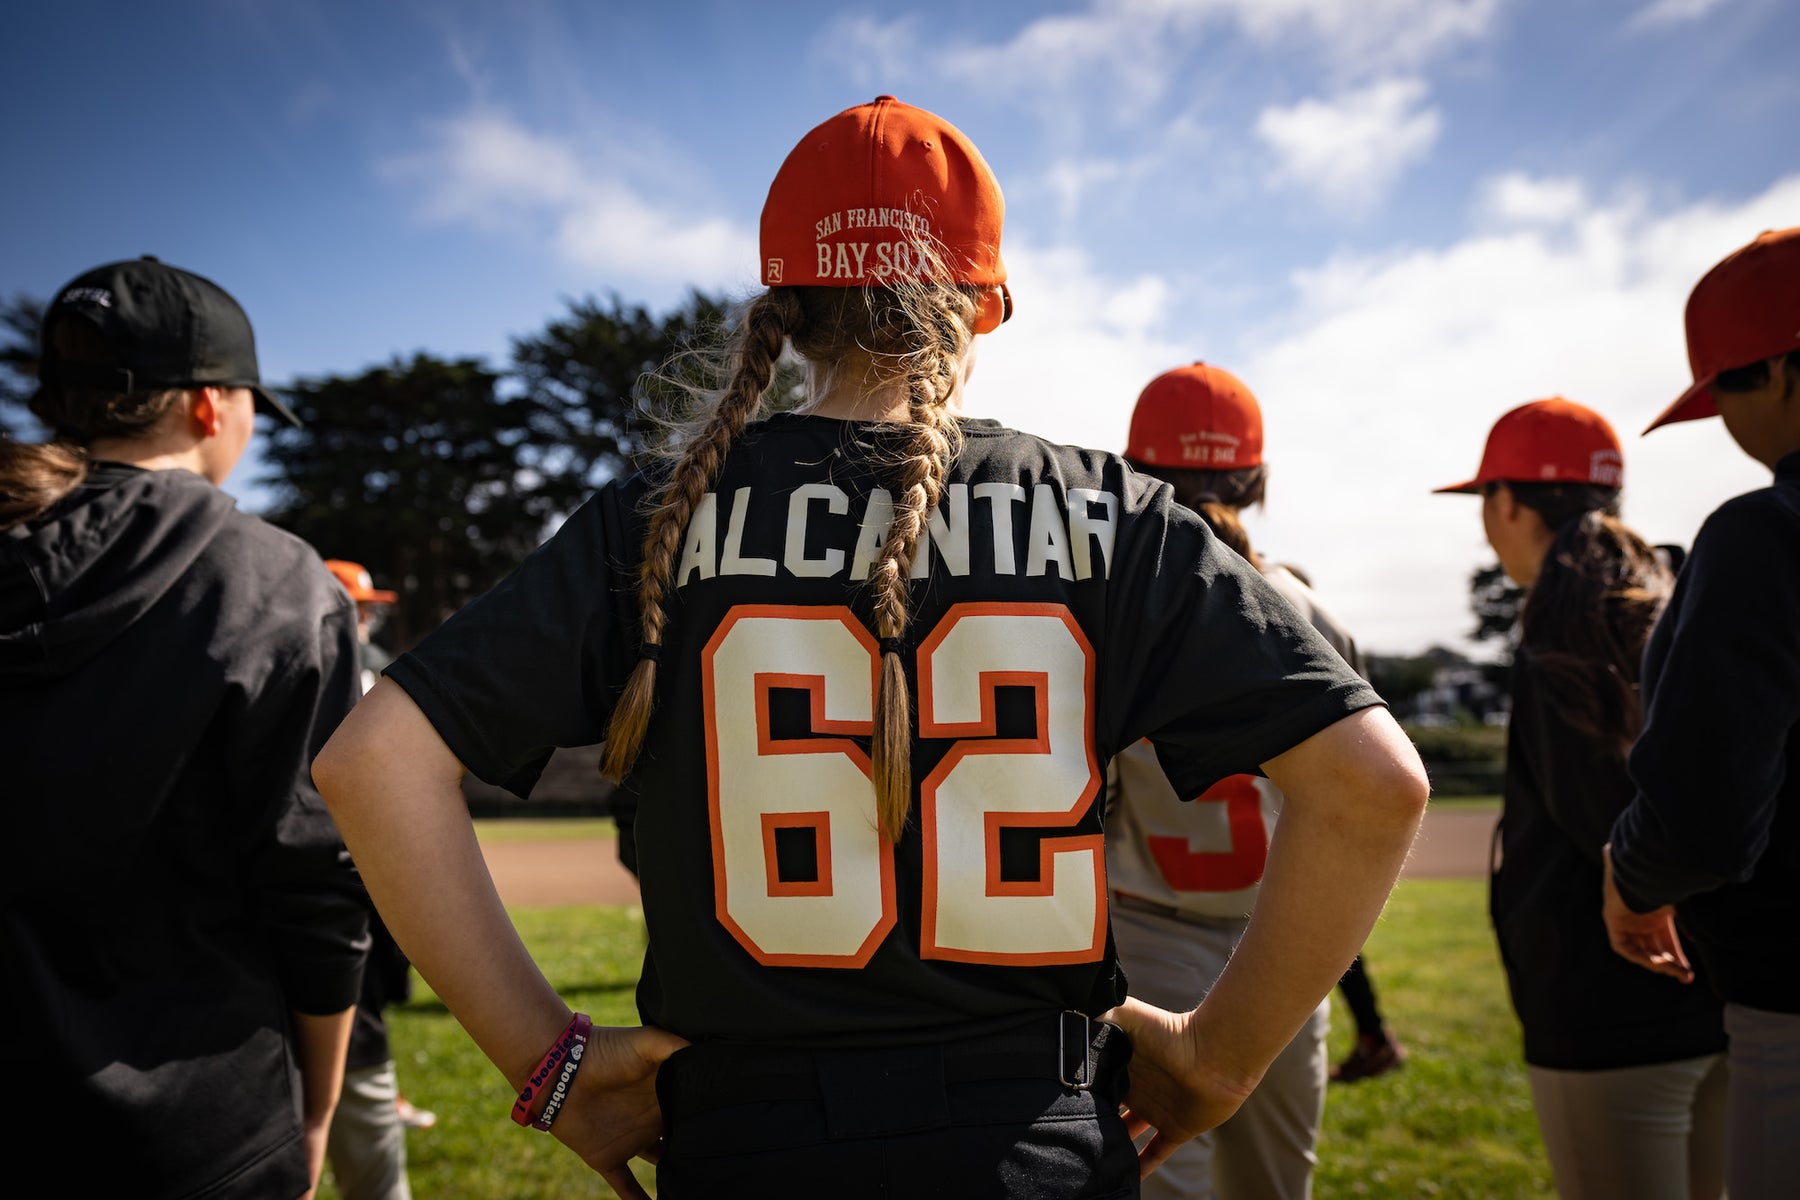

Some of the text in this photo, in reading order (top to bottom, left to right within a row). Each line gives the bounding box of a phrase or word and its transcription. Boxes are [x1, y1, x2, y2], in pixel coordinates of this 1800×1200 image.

[815, 207, 930, 241] SAN FRANCISCO
[815, 241, 933, 279] BAY SOX
[677, 482, 1119, 588] ALCANTAR
[700, 602, 1108, 969] 62
[540, 1062, 578, 1126] boobies!
